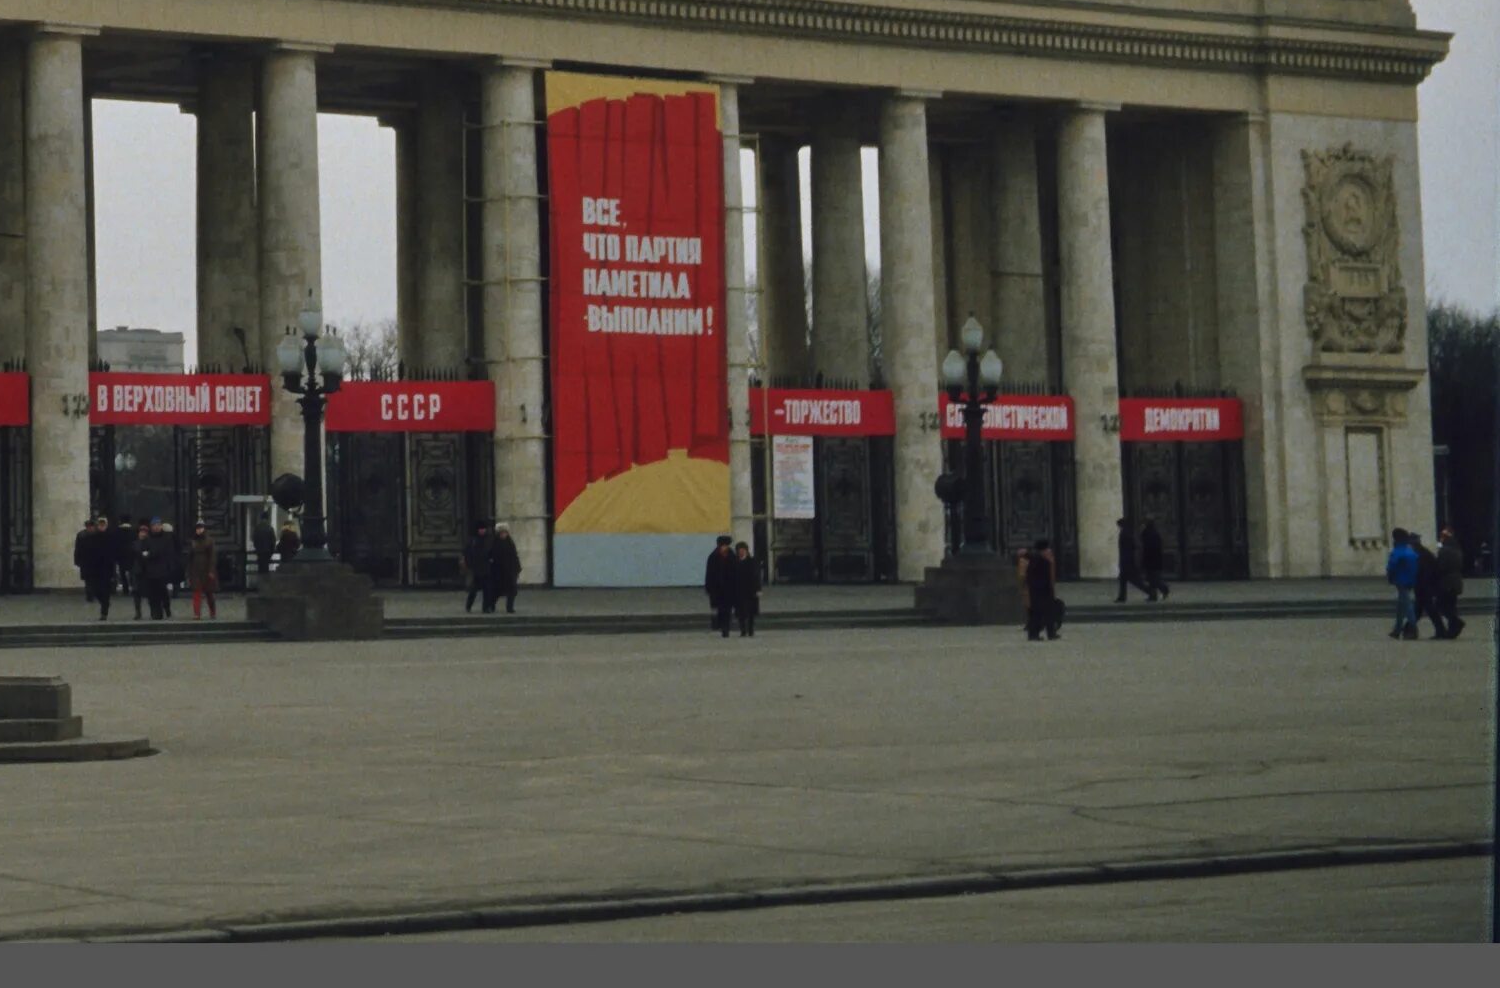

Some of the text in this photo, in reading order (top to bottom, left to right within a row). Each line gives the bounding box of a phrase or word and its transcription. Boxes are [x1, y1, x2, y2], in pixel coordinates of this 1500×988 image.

[582, 196, 627, 228] ВСЕ,
[582, 232, 702, 265] ЧТО ПАРТИЯ
[582, 268, 691, 299] НАМЕТИЛА
[97, 382, 262, 413] В ВЕРХОВНЫЙ СОВЕТ
[381, 393, 441, 421] СССР
[1144, 407, 1220, 433] ДЕМОКРАТИИ
